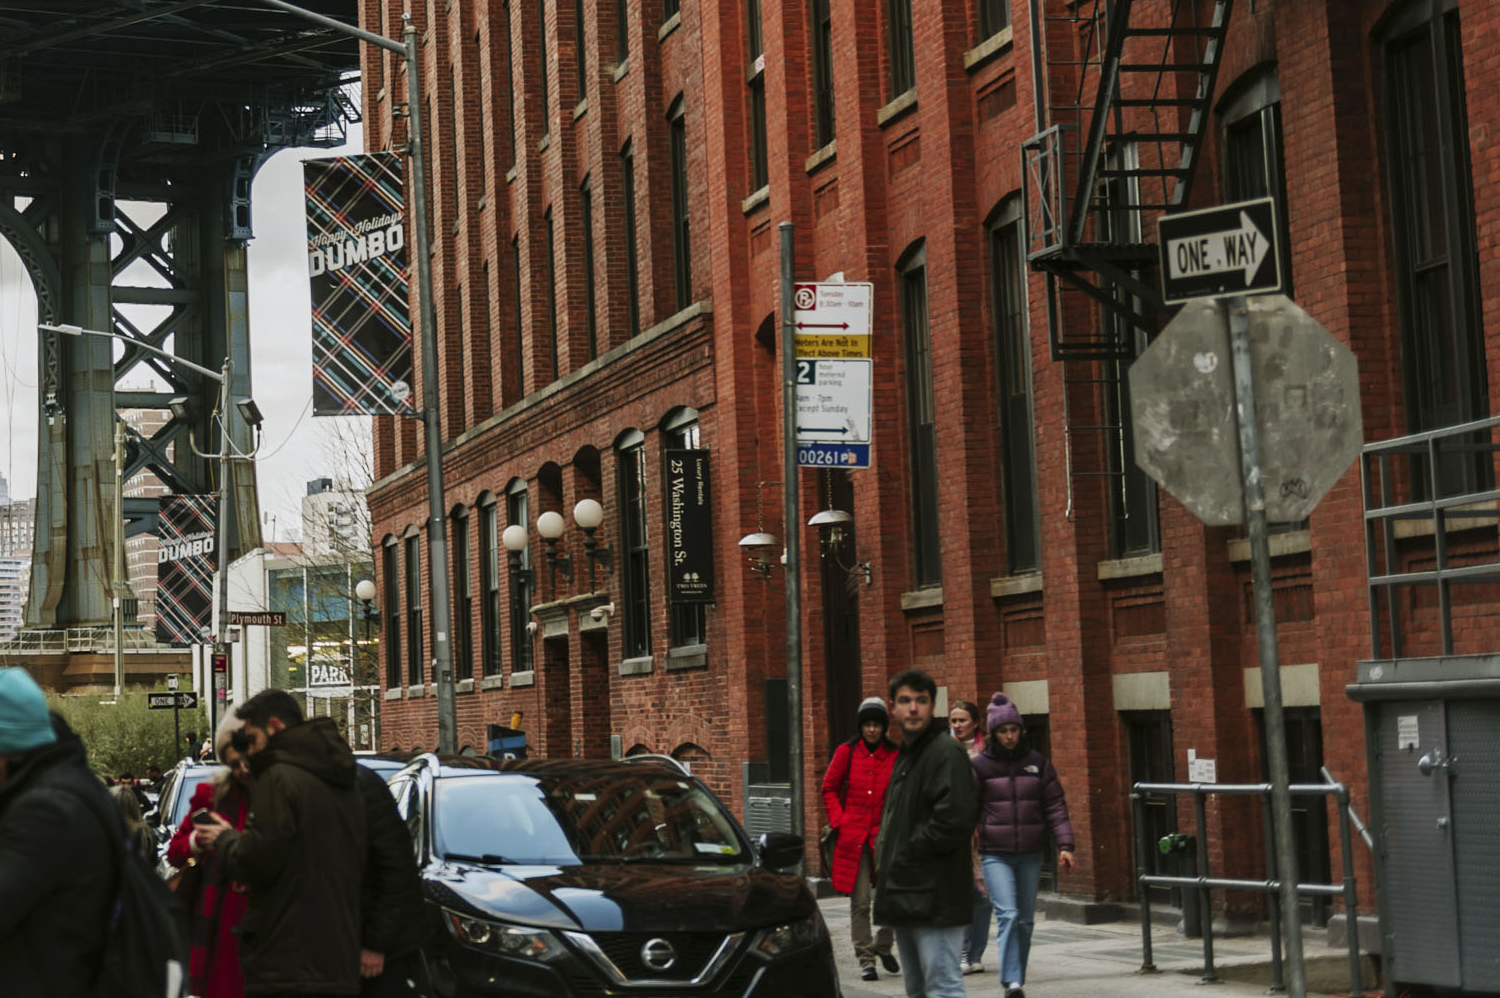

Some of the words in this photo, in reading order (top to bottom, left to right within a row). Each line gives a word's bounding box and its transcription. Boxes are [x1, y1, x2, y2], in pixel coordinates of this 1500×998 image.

[309, 231, 347, 249] Happy
[352, 212, 404, 235] Holidays
[309, 223, 404, 278] DUMBO
[1177, 238, 1211, 274] ONE
[1223, 231, 1257, 267] WAY
[820, 338, 833, 347] Are
[836, 338, 848, 347] Not
[818, 349, 840, 357] Above
[842, 349, 863, 357] Times
[797, 361, 810, 383] 2
[821, 405, 848, 414] Sunday
[800, 450, 838, 464] 00261
[671, 459, 684, 474] 25
[670, 477, 685, 548] Washington
[158, 537, 214, 564] DUMBO
[674, 550, 687, 566] St.
[231, 613, 272, 625] Plymouth
[274, 614, 283, 624] St
[311, 664, 350, 683] PARK
[154, 697, 169, 705] ONE
